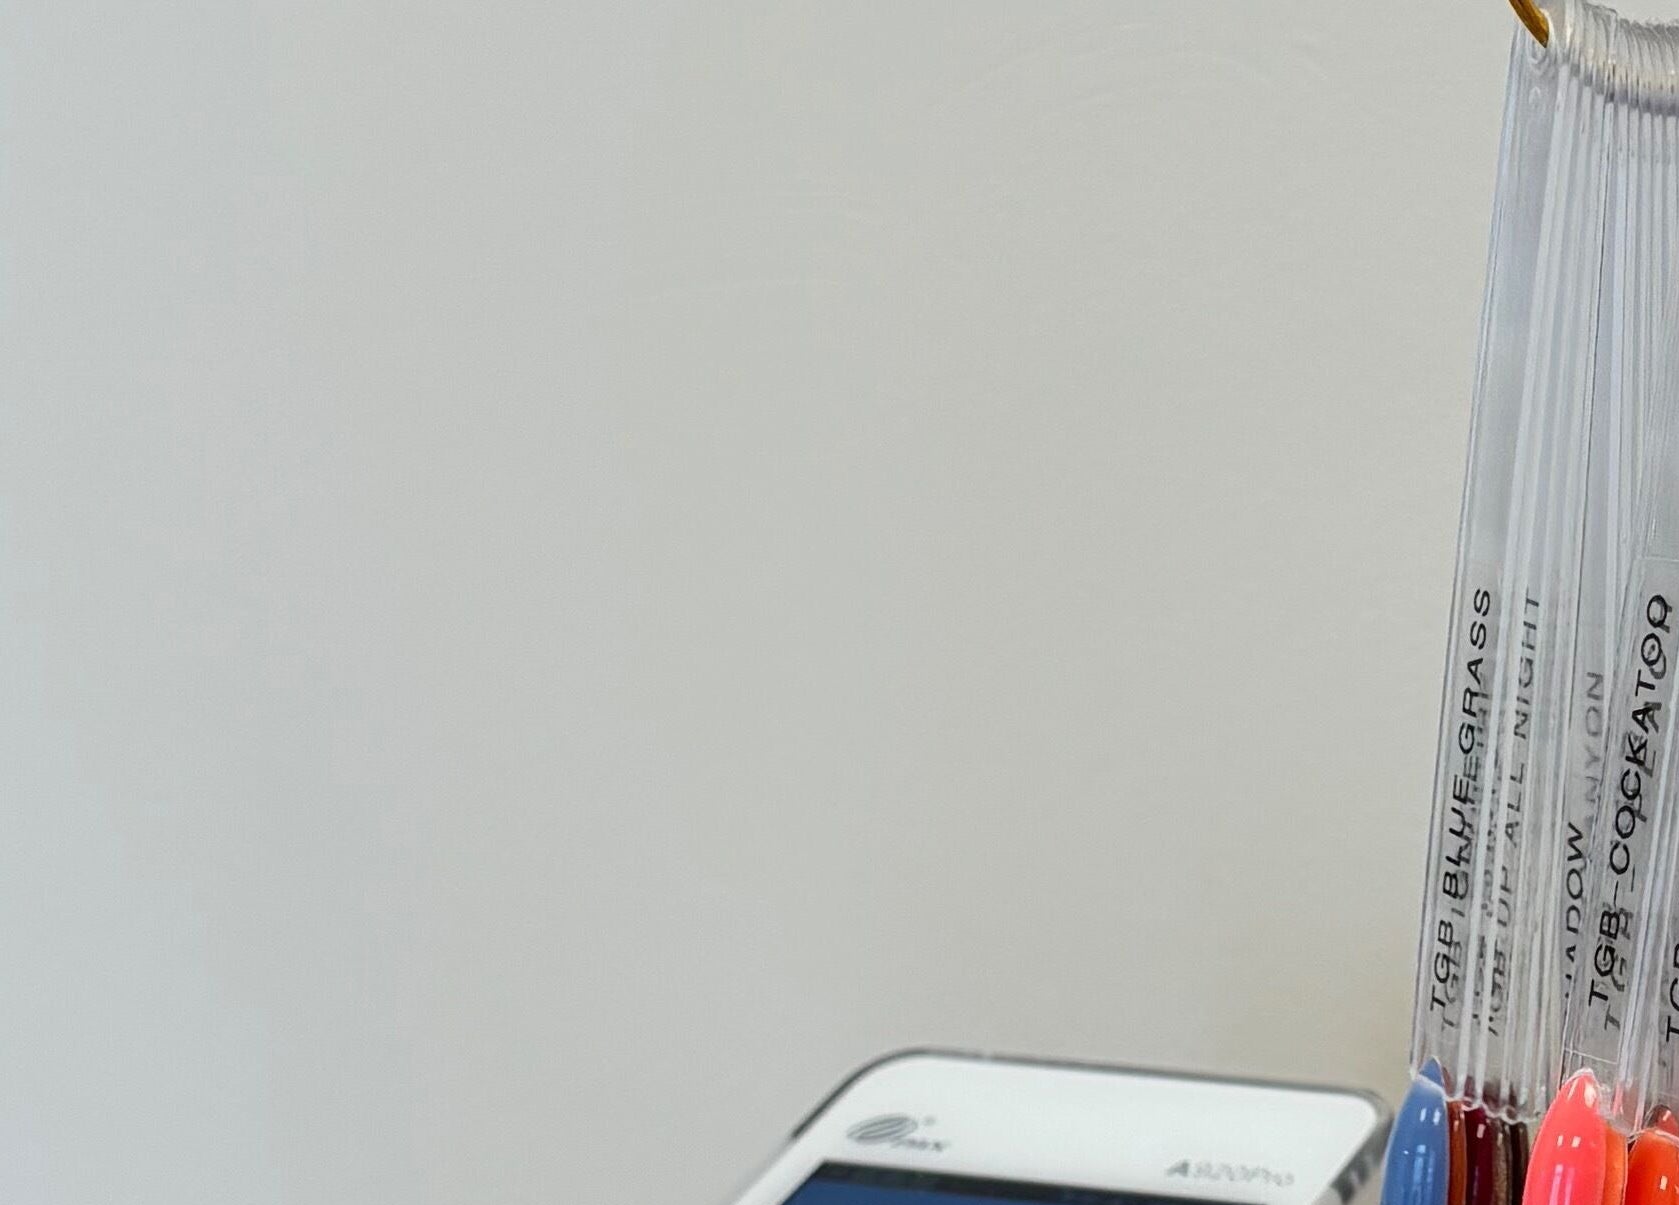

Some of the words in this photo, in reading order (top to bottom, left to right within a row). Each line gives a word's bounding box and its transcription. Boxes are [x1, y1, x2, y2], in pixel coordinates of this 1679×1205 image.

[1430, 920, 1454, 1011] TGB
[1442, 774, 1470, 900] BLUE
[1457, 587, 1491, 754] GRASS
